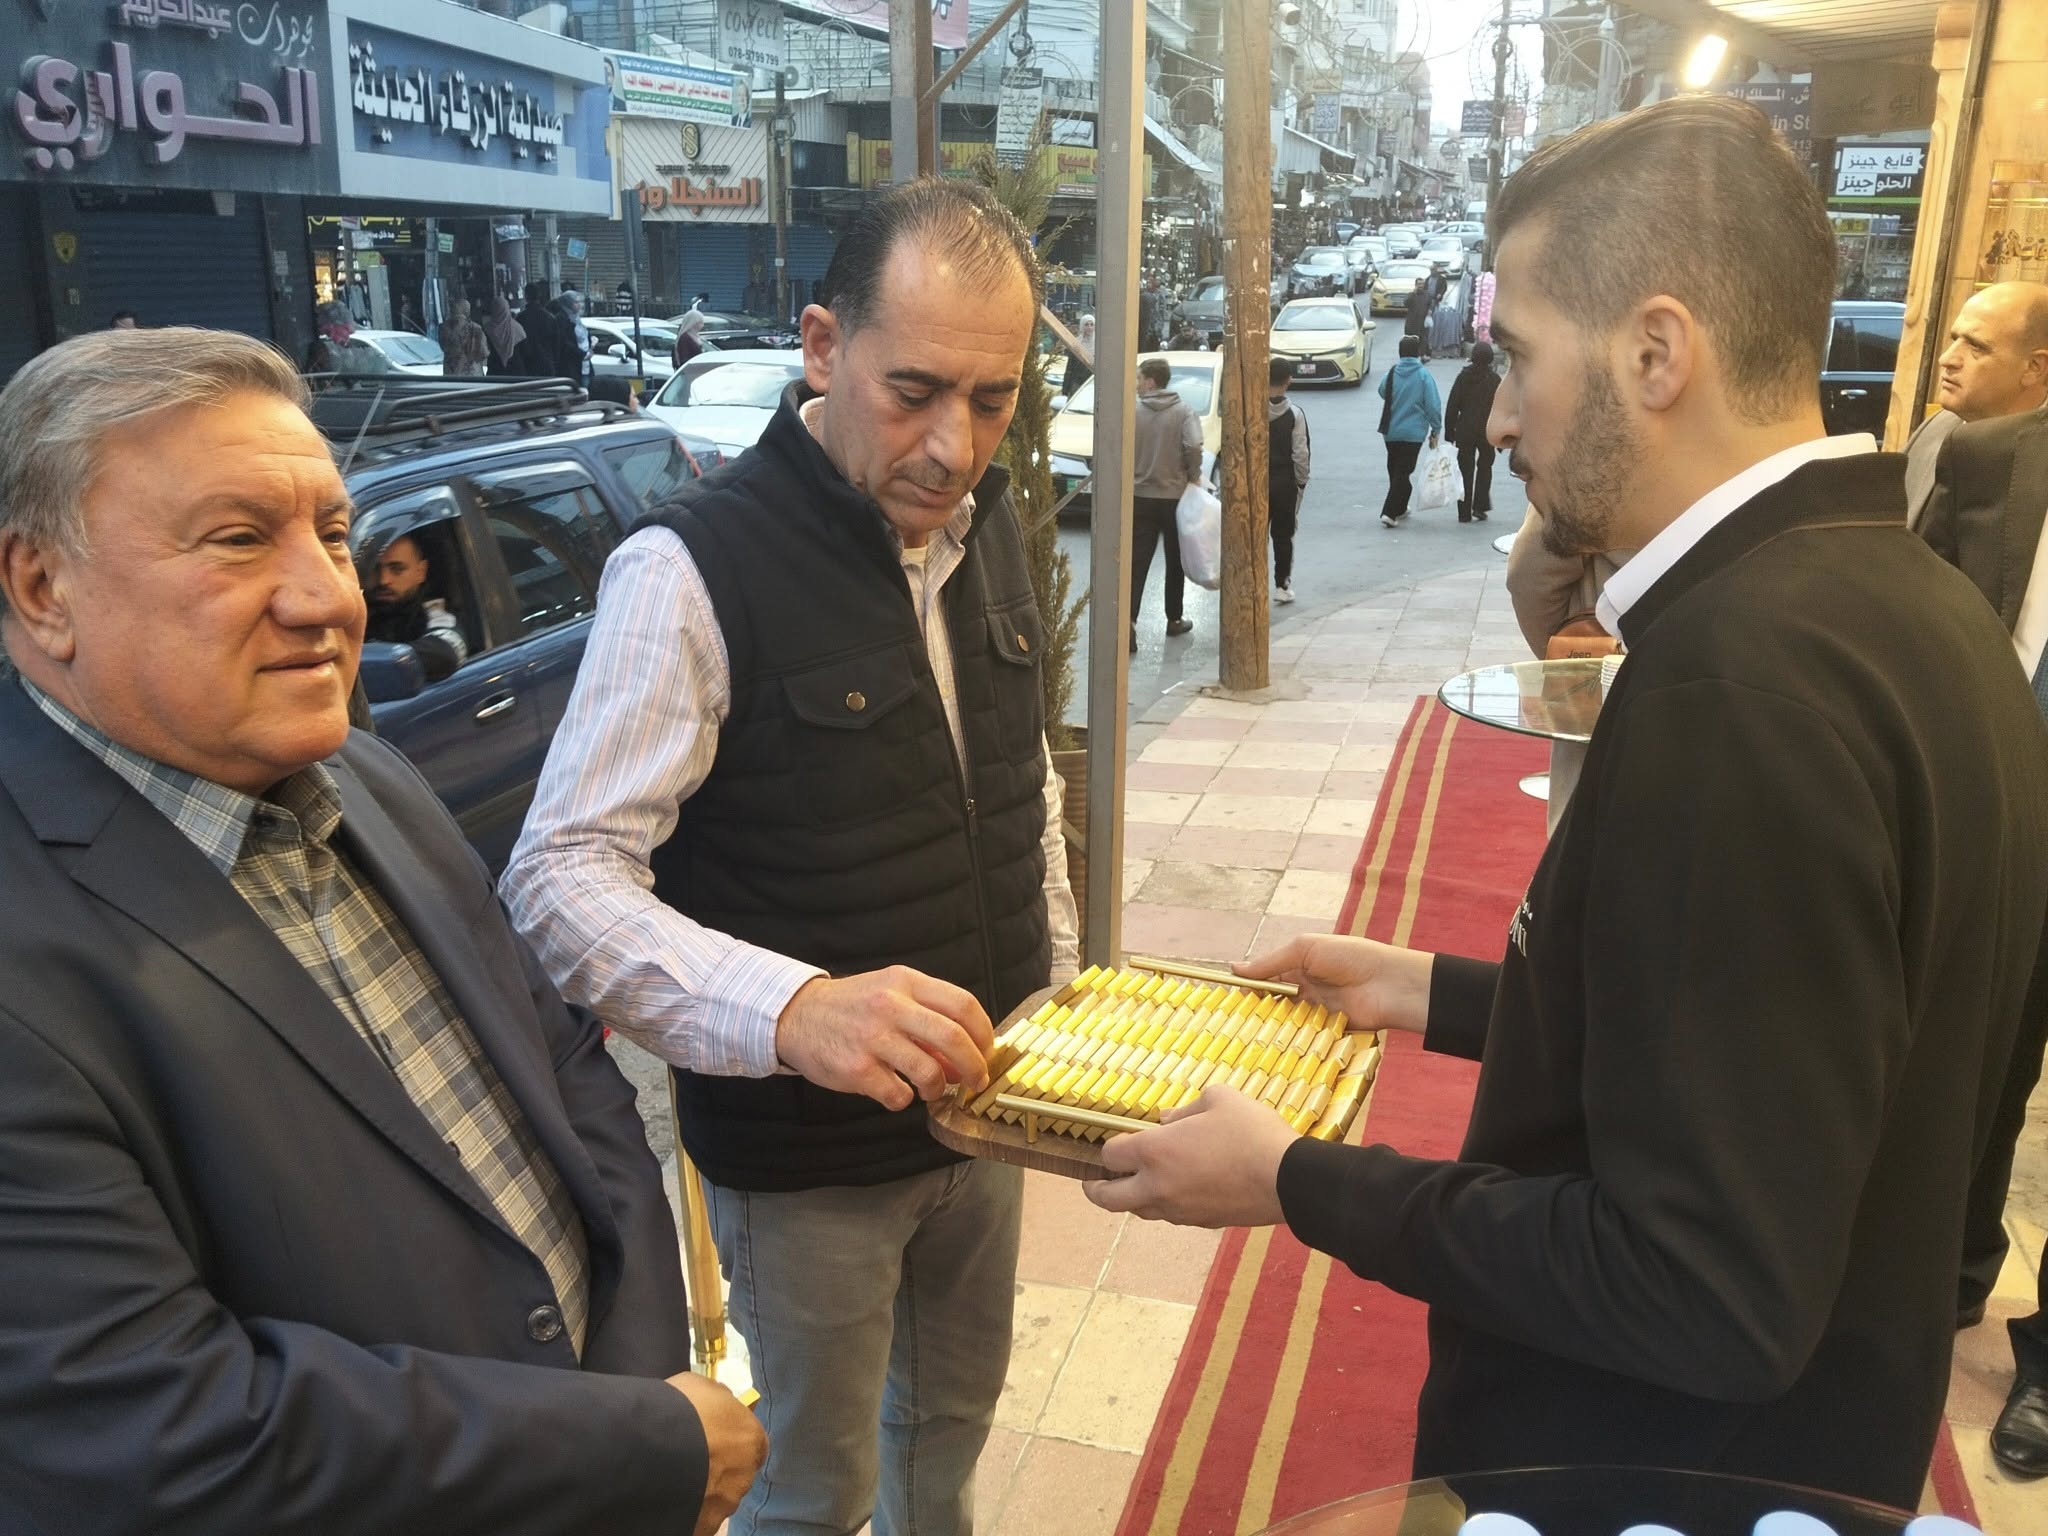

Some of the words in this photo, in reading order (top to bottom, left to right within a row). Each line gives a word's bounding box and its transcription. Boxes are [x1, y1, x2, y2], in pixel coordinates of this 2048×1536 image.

[349, 41, 435, 144] الحديثة
[1746, 87, 1786, 101] الملك
[14, 41, 322, 171] الحواري
[440, 69, 503, 152] الزرقاء
[503, 80, 563, 161] صيدلية
[1848, 154, 1879, 169] جينز
[1884, 152, 1914, 170] فايع
[1838, 175, 1874, 193] جينز
[1876, 175, 1912, 193] الحلو
